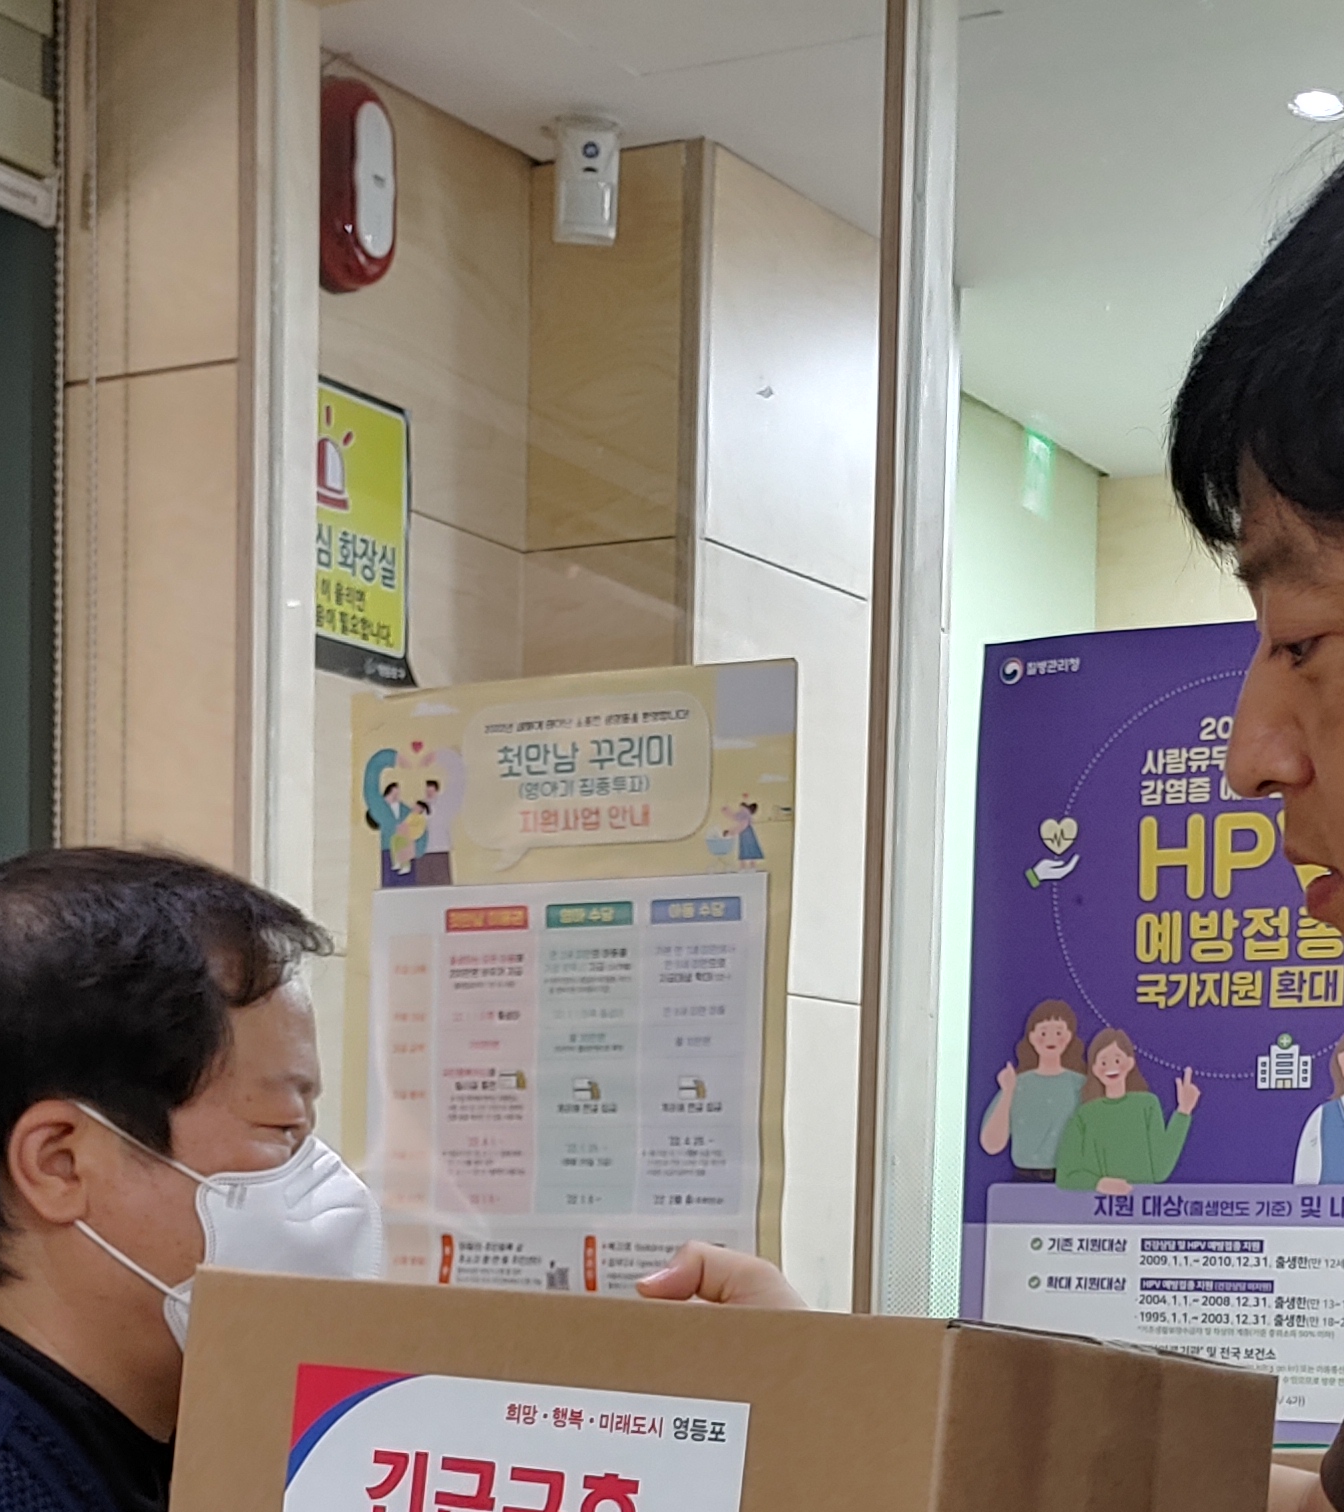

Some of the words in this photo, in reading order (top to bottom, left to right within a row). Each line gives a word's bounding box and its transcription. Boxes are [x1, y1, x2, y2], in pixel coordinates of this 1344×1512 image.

[317, 523, 332, 569] 심
[338, 530, 397, 590] 화장실
[498, 740, 579, 779] 첫만남
[589, 734, 673, 770] 꾸러미
[1140, 777, 1211, 806] 감염증
[520, 807, 601, 834] 지원사업
[608, 803, 651, 830] 안내
[1136, 906, 1344, 964] 예방접종
[1136, 971, 1262, 1009] 국가지원
[1275, 969, 1339, 1005] 확대
[1093, 1195, 1134, 1217] 지원
[1300, 1196, 1321, 1219] 및
[1047, 1237, 1073, 1252] 기존
[1076, 1238, 1128, 1253] 지원대상
[1075, 1276, 1127, 1291] 지원대상
[1219, 1346, 1241, 1360] 전국
[1242, 1347, 1276, 1361] 보건소
[672, 1416, 727, 1444] 영등포
